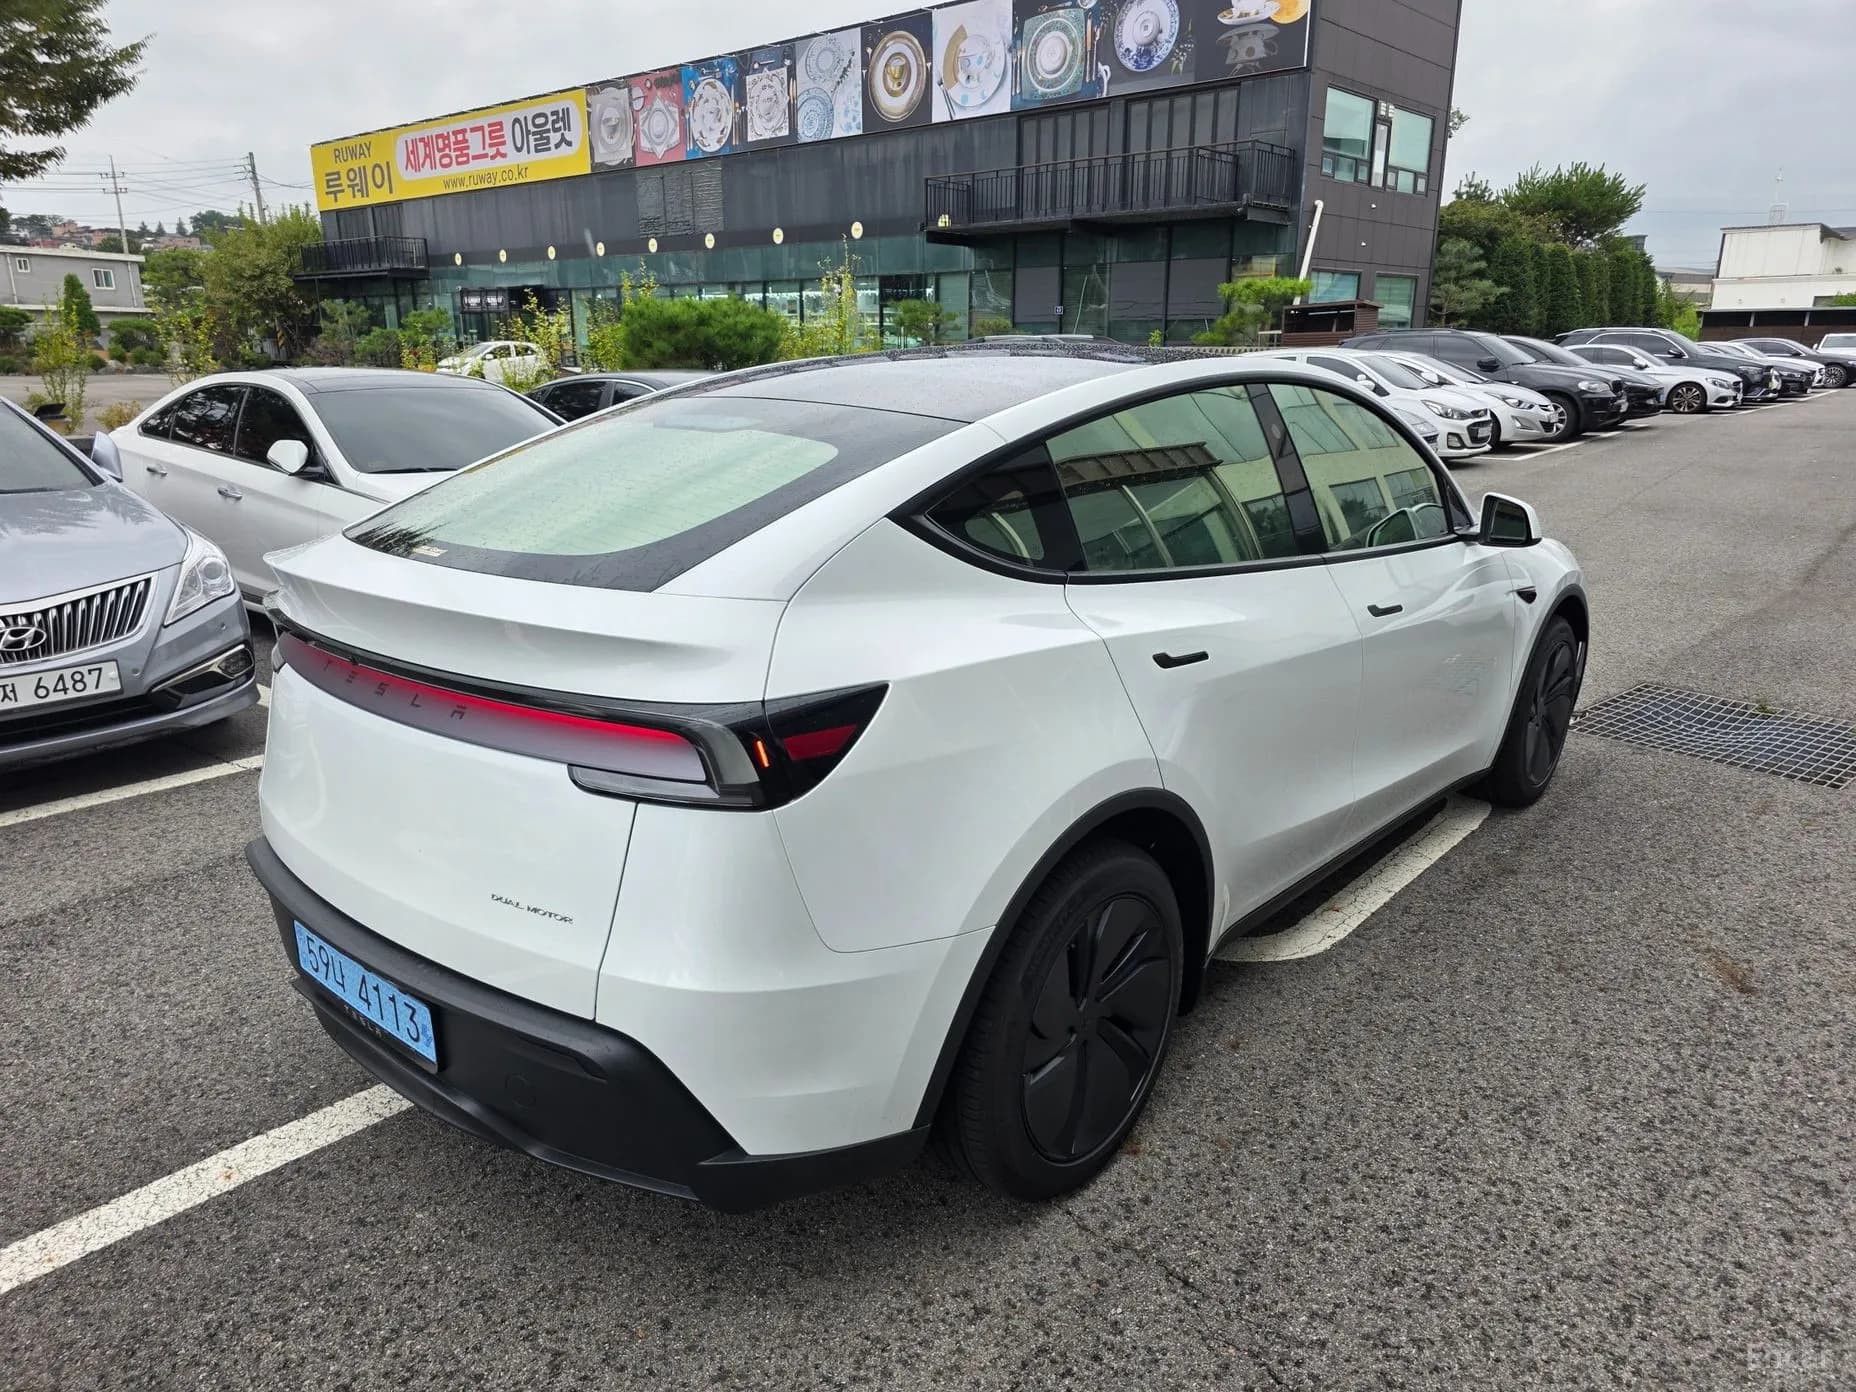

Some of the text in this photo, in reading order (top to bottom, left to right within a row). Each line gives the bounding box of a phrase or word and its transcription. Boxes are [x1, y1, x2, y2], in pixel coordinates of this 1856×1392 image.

[511, 106, 573, 155] 아울렛
[333, 141, 372, 164] RUWAY
[325, 161, 393, 203] 루웨이
[443, 164, 528, 190] www.ruway.co.kr
[34, 667, 103, 699] 6487
[323, 660, 467, 720] TESLA
[491, 893, 574, 925] DUAL MOTOR
[358, 974, 420, 1043] 4113
